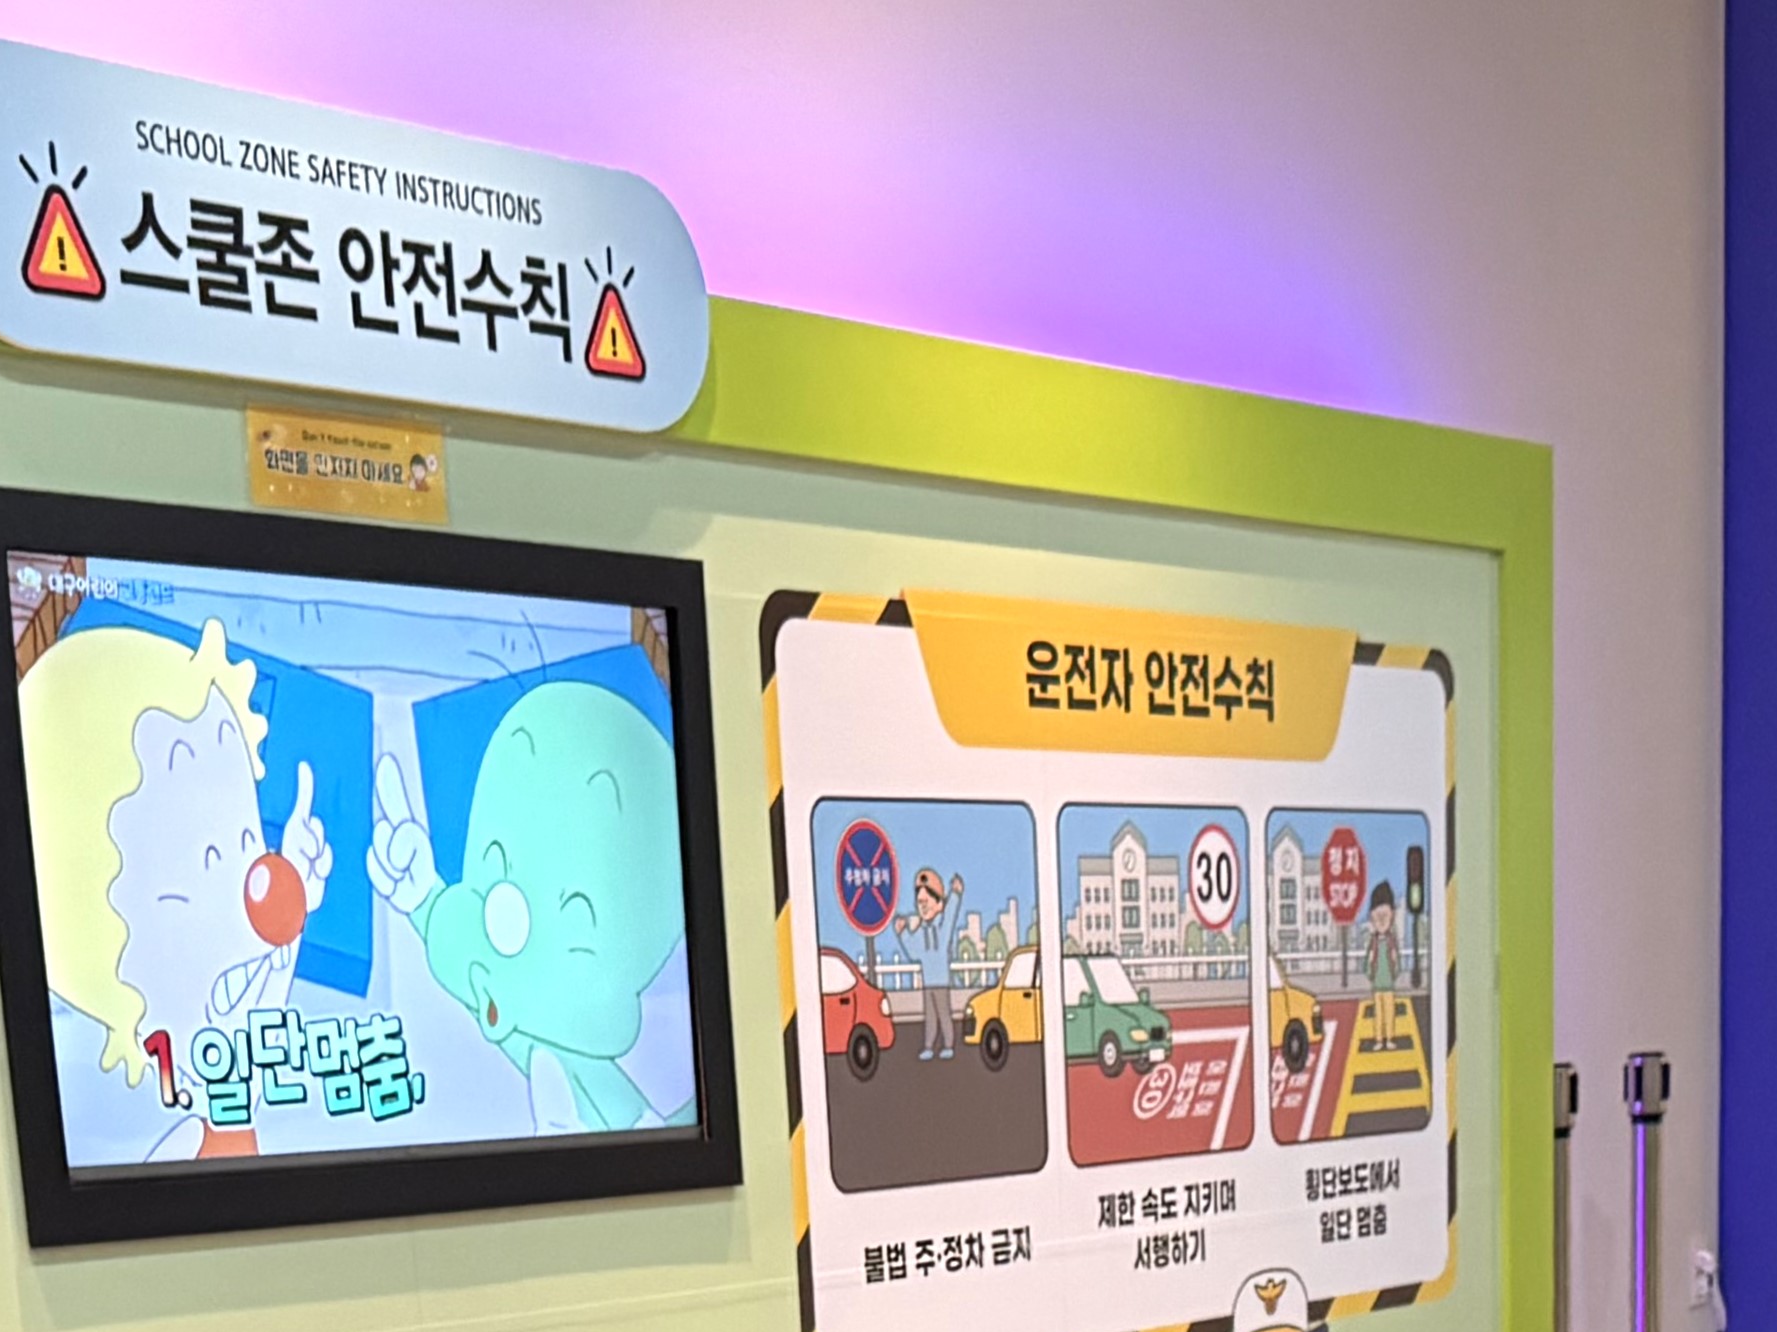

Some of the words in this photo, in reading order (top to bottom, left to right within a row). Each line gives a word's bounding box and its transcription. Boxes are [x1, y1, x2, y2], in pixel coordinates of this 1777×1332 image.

[135, 120, 233, 168] SCHOOL
[238, 140, 301, 180] ZONE
[307, 153, 387, 197] SAFETY
[394, 169, 544, 226] INSTRUCTIONS
[120, 190, 321, 323] 스쿨존
[338, 226, 573, 364] 안전수칙
[1026, 640, 1135, 714] 운전자
[1144, 650, 1275, 723] 안전수칙
[1196, 851, 1233, 904] 30
[1097, 1189, 1136, 1229] 제한
[1141, 1185, 1178, 1223] 속도
[1183, 1178, 1237, 1217] 지키며
[1304, 1158, 1401, 1202] 횡단보도에서
[1133, 1229, 1207, 1271] 서행하기
[1319, 1205, 1353, 1244] 일단
[1356, 1203, 1388, 1238] 멈춤
[864, 1242, 908, 1284] 불법
[991, 1225, 1032, 1266] 금지
